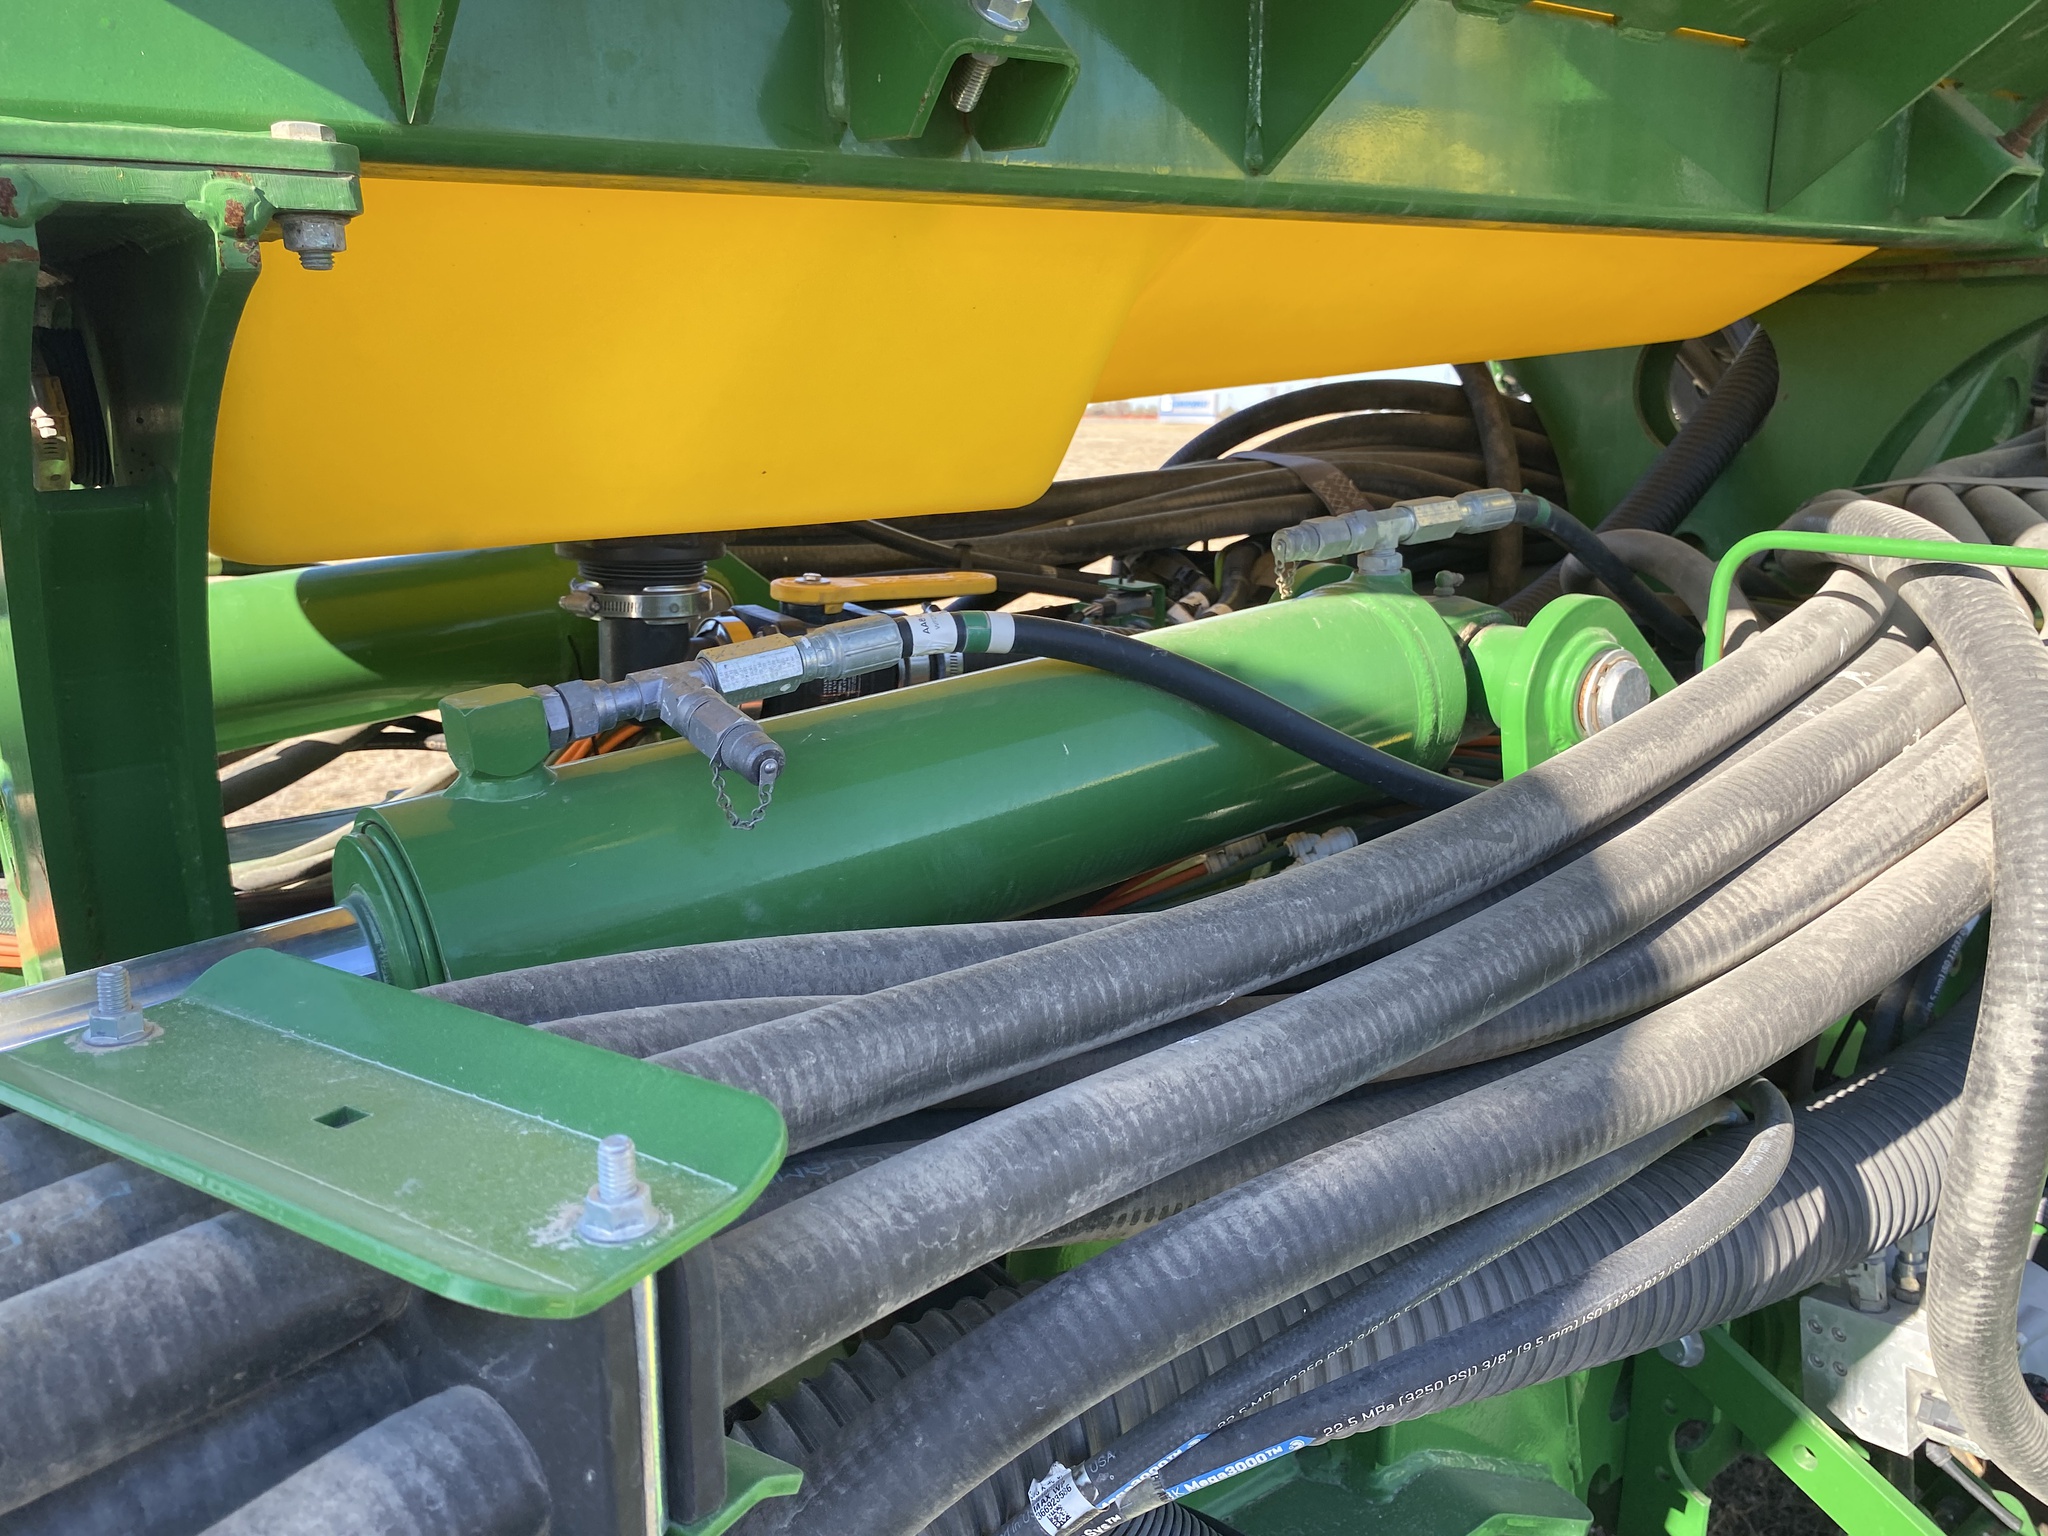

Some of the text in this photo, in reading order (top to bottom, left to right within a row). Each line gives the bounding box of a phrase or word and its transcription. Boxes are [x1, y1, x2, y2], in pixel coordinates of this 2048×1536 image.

[1323, 1416, 1358, 1437] 22.5
[1361, 1403, 1395, 1421] MPa
[1090, 1450, 1117, 1473] USA
